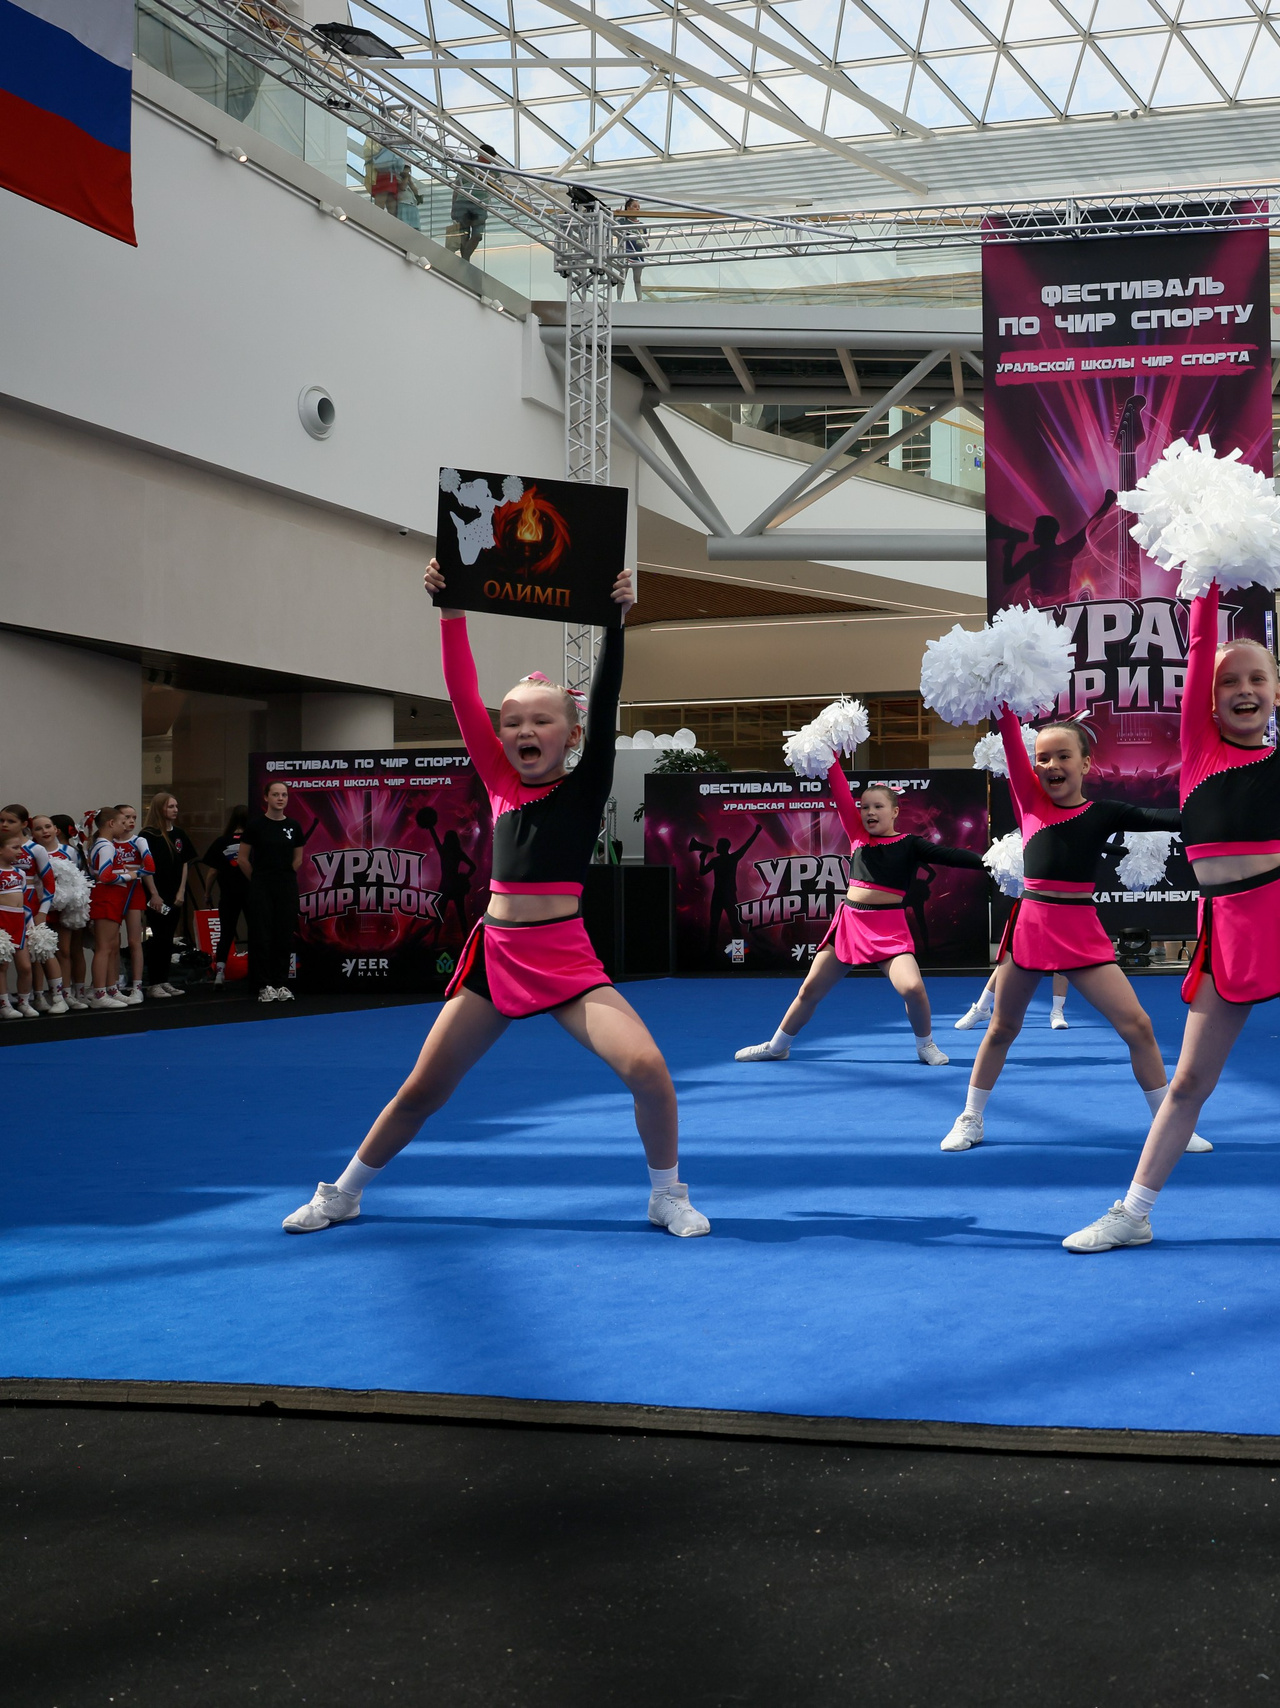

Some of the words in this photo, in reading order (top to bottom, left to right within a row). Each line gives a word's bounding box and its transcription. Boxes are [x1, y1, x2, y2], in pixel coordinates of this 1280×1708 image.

[1041, 276, 1225, 307] ФЕСТИВАЛЬ
[998, 314, 1040, 336] ПО
[1054, 312, 1116, 334] ЧИР
[1130, 303, 1254, 330] СПОРТУ
[996, 357, 1075, 374] УРАЛЬСКОЙ
[1081, 356, 1135, 371] ШКОЛЫ
[1141, 355, 1174, 368] ЧИР
[1181, 350, 1250, 367] СПОРТА
[483, 579, 571, 608] ОЛИМП
[1046, 602, 1232, 663] УРА
[1117, 666, 1150, 708] И
[266, 759, 349, 772] ФЕСТИВАЛЬ
[354, 758, 374, 769] ПО
[380, 757, 409, 768] ЧИР
[414, 756, 471, 767] СПОРТУ
[284, 779, 340, 789] РАЛЬСКАЯ
[343, 778, 380, 788] ШКОЛА
[384, 778, 406, 787] ЧИР
[409, 777, 452, 787] СПОРТА
[699, 782, 793, 796] ФЕСТИВАЛЬ
[800, 781, 822, 792] ПО
[723, 801, 785, 811] УРАЛЬСКАЯ
[789, 800, 825, 810] ШКОЛА
[315, 849, 422, 889] УРАЛ
[757, 856, 848, 897] УРА
[299, 888, 354, 920] ЧИР
[359, 886, 377, 911] И
[383, 886, 438, 918] РОК
[740, 894, 802, 928] ЧИР
[807, 893, 828, 918] И
[1091, 890, 1200, 903] КАТЕРИНБУР
